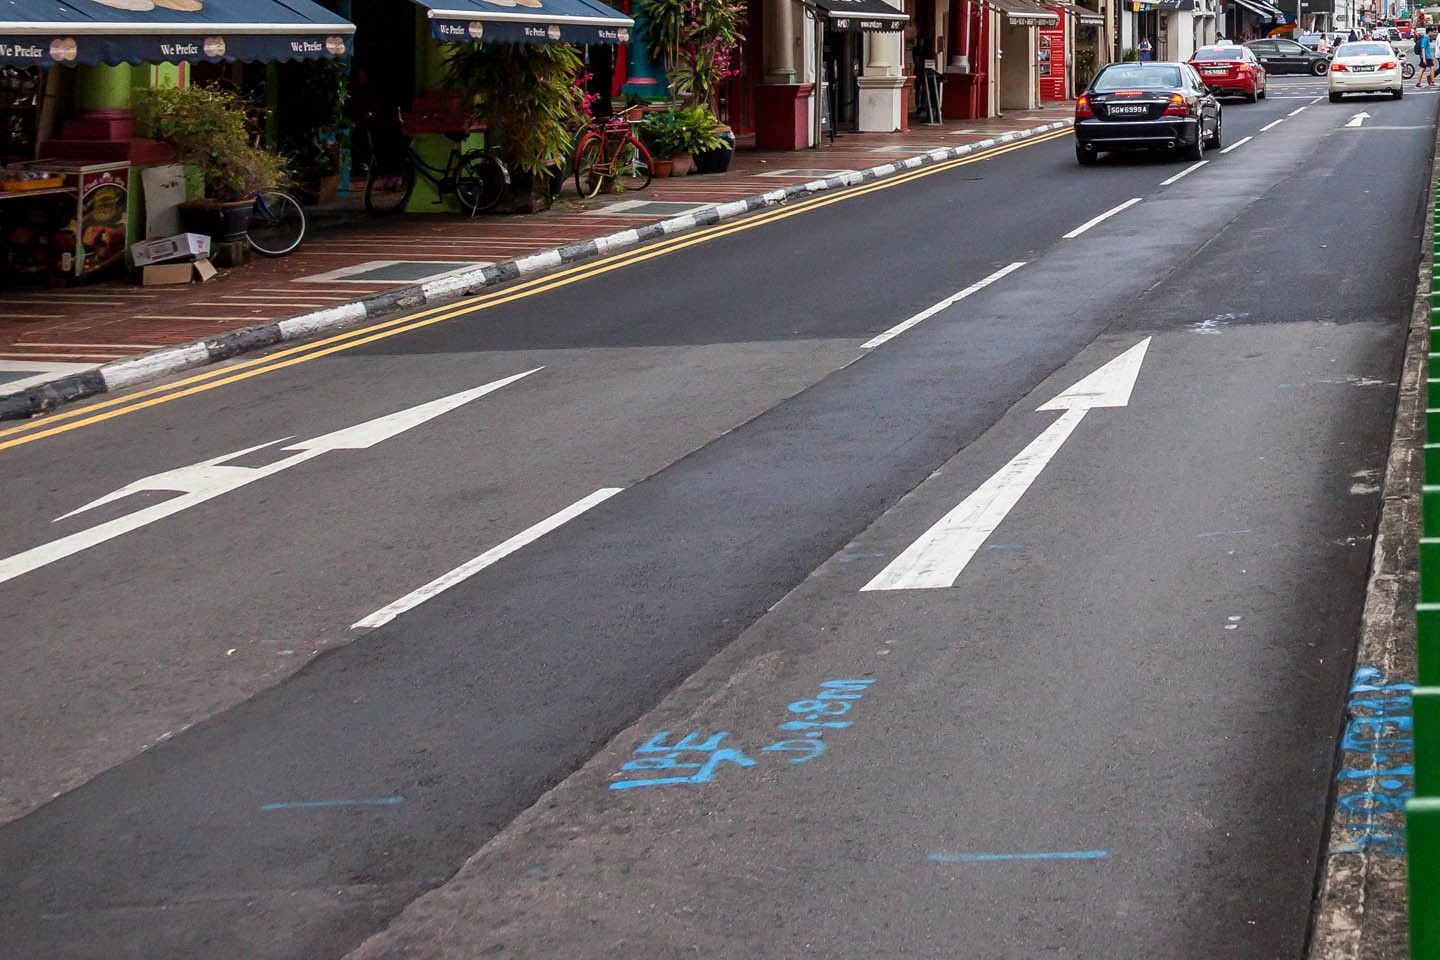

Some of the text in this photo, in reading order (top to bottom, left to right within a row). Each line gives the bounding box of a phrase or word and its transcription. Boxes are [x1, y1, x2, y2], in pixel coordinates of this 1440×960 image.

[14, 44, 43, 57] Prefer
[161, 44, 175, 55] We
[176, 44, 198, 55] Prefer
[291, 42, 322, 52] We Prefer
